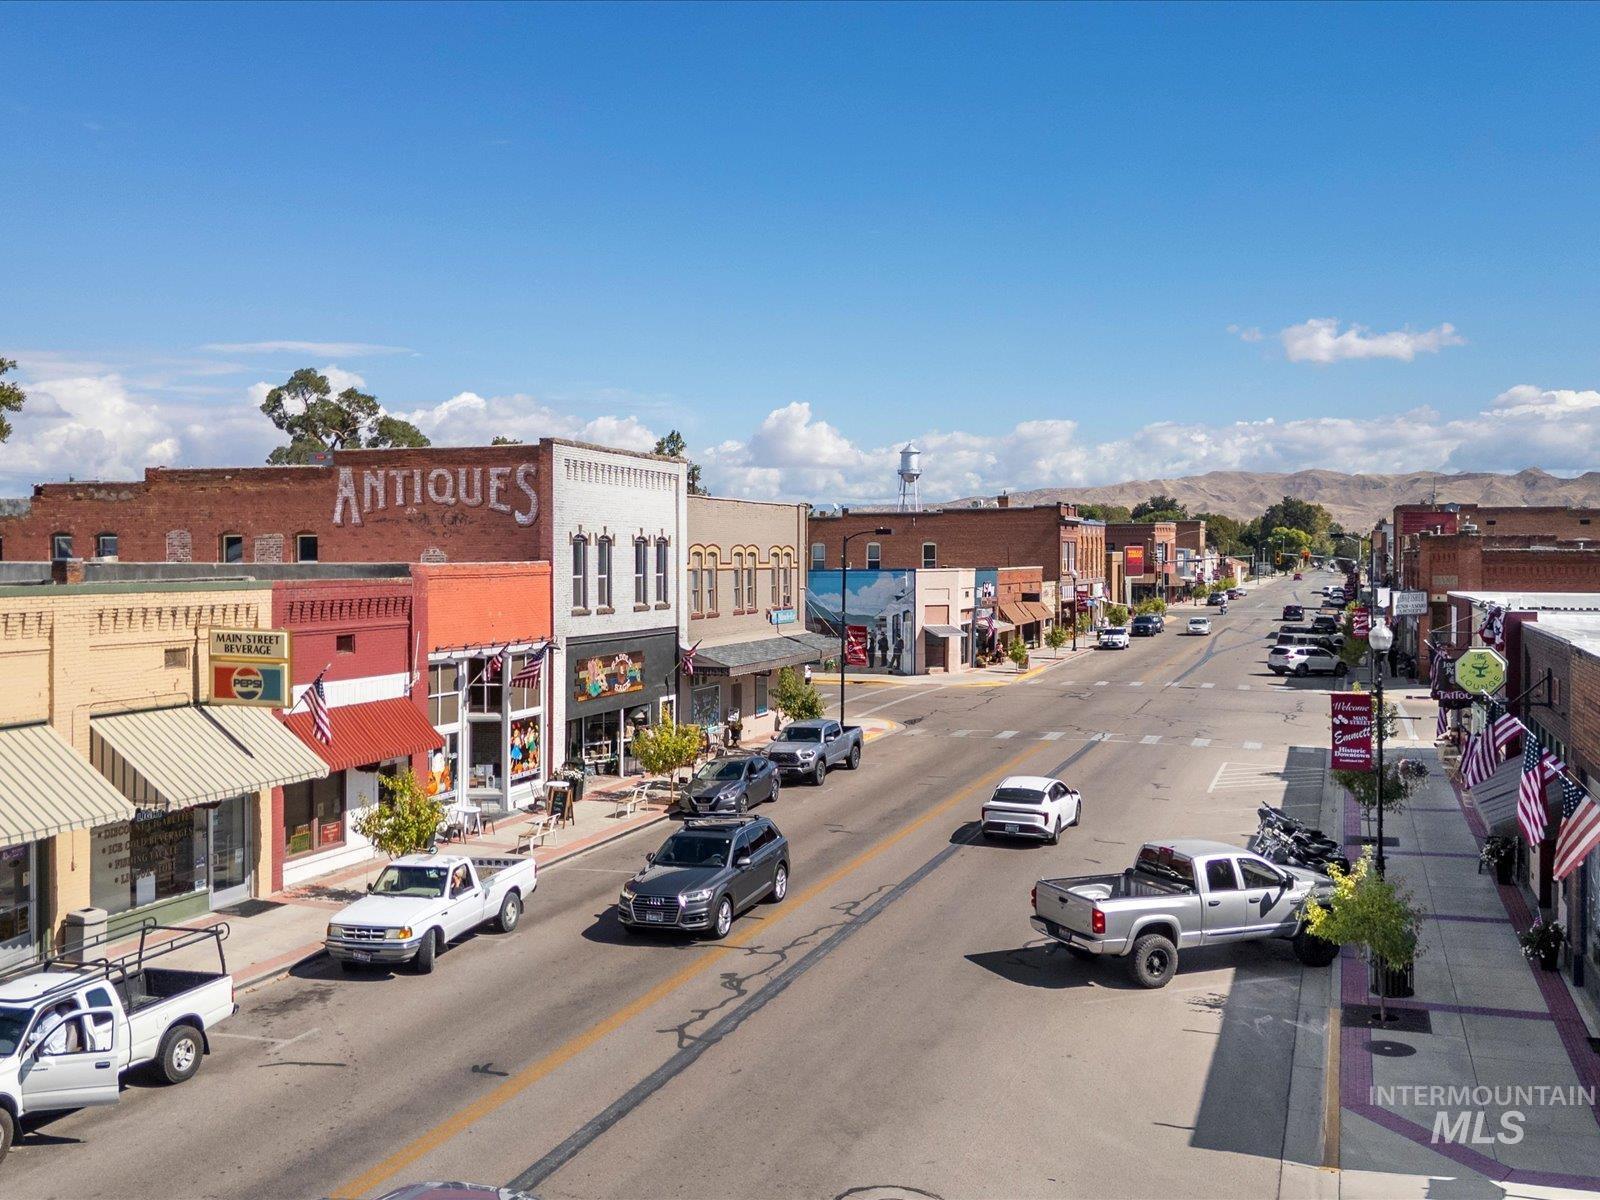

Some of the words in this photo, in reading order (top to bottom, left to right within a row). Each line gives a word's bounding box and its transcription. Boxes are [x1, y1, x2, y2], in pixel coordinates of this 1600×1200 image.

[333, 463, 539, 527] ANTIQUES
[216, 633, 242, 643] MAIN
[246, 634, 280, 645] STREET
[224, 644, 272, 655] BEVERAGE
[233, 678, 263, 688] PEPSI
[1460, 675, 1502, 690] LOUNGE
[1333, 702, 1369, 712] Welcome
[1334, 727, 1370, 744] Emmett
[1338, 746, 1367, 754] Historic
[104, 822, 143, 840] DISCONT
